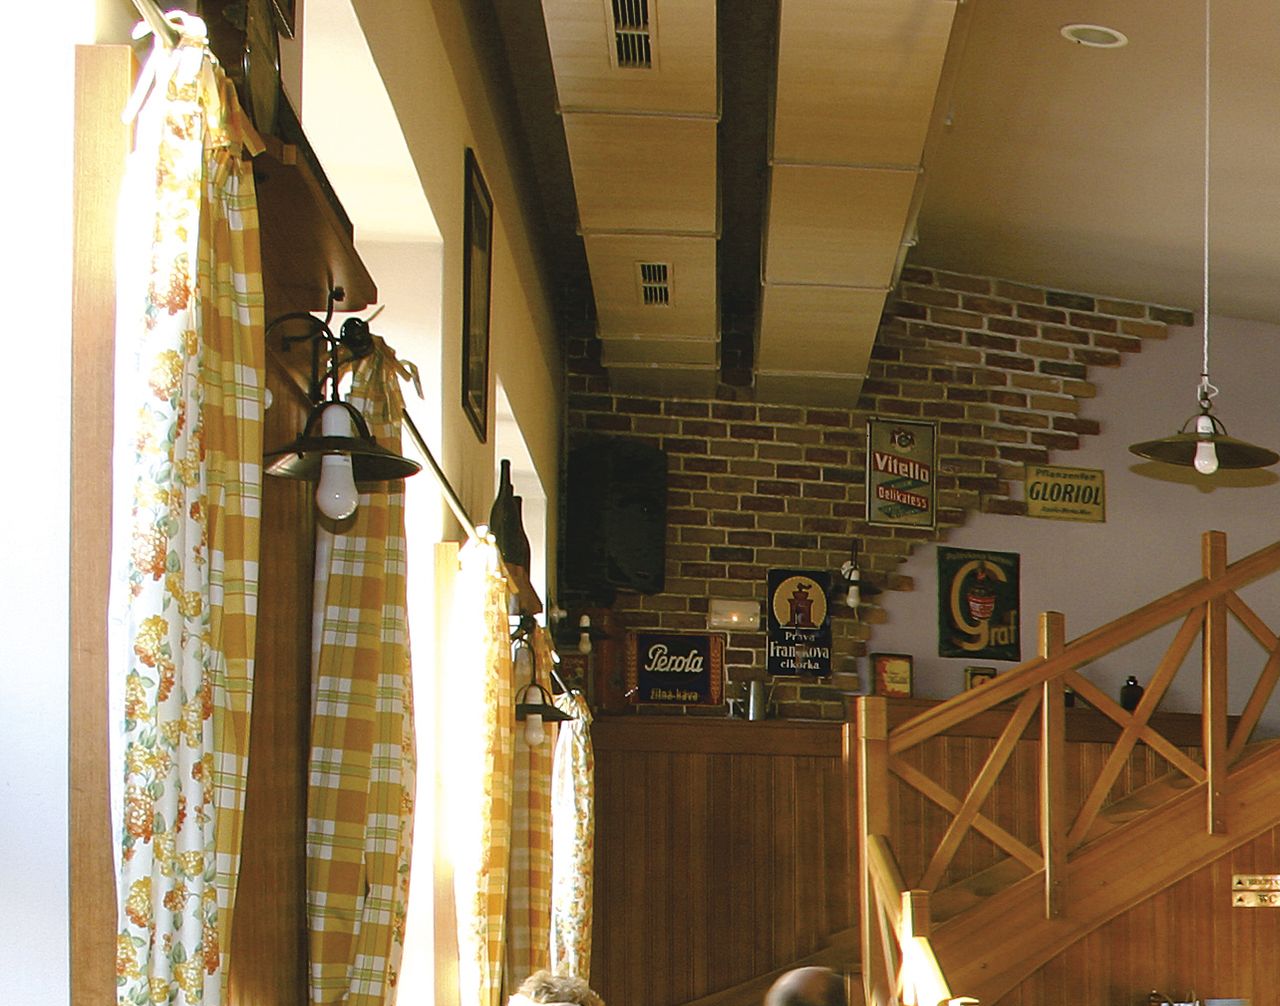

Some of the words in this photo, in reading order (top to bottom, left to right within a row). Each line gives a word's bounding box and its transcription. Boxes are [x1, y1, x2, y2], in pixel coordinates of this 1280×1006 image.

[874, 452, 929, 483] Vitello
[878, 486, 928, 509] Delikatess
[1029, 481, 1100, 506] GLORIOL
[645, 643, 704, 673] Perola
[1257, 894, 1277, 903] WC
